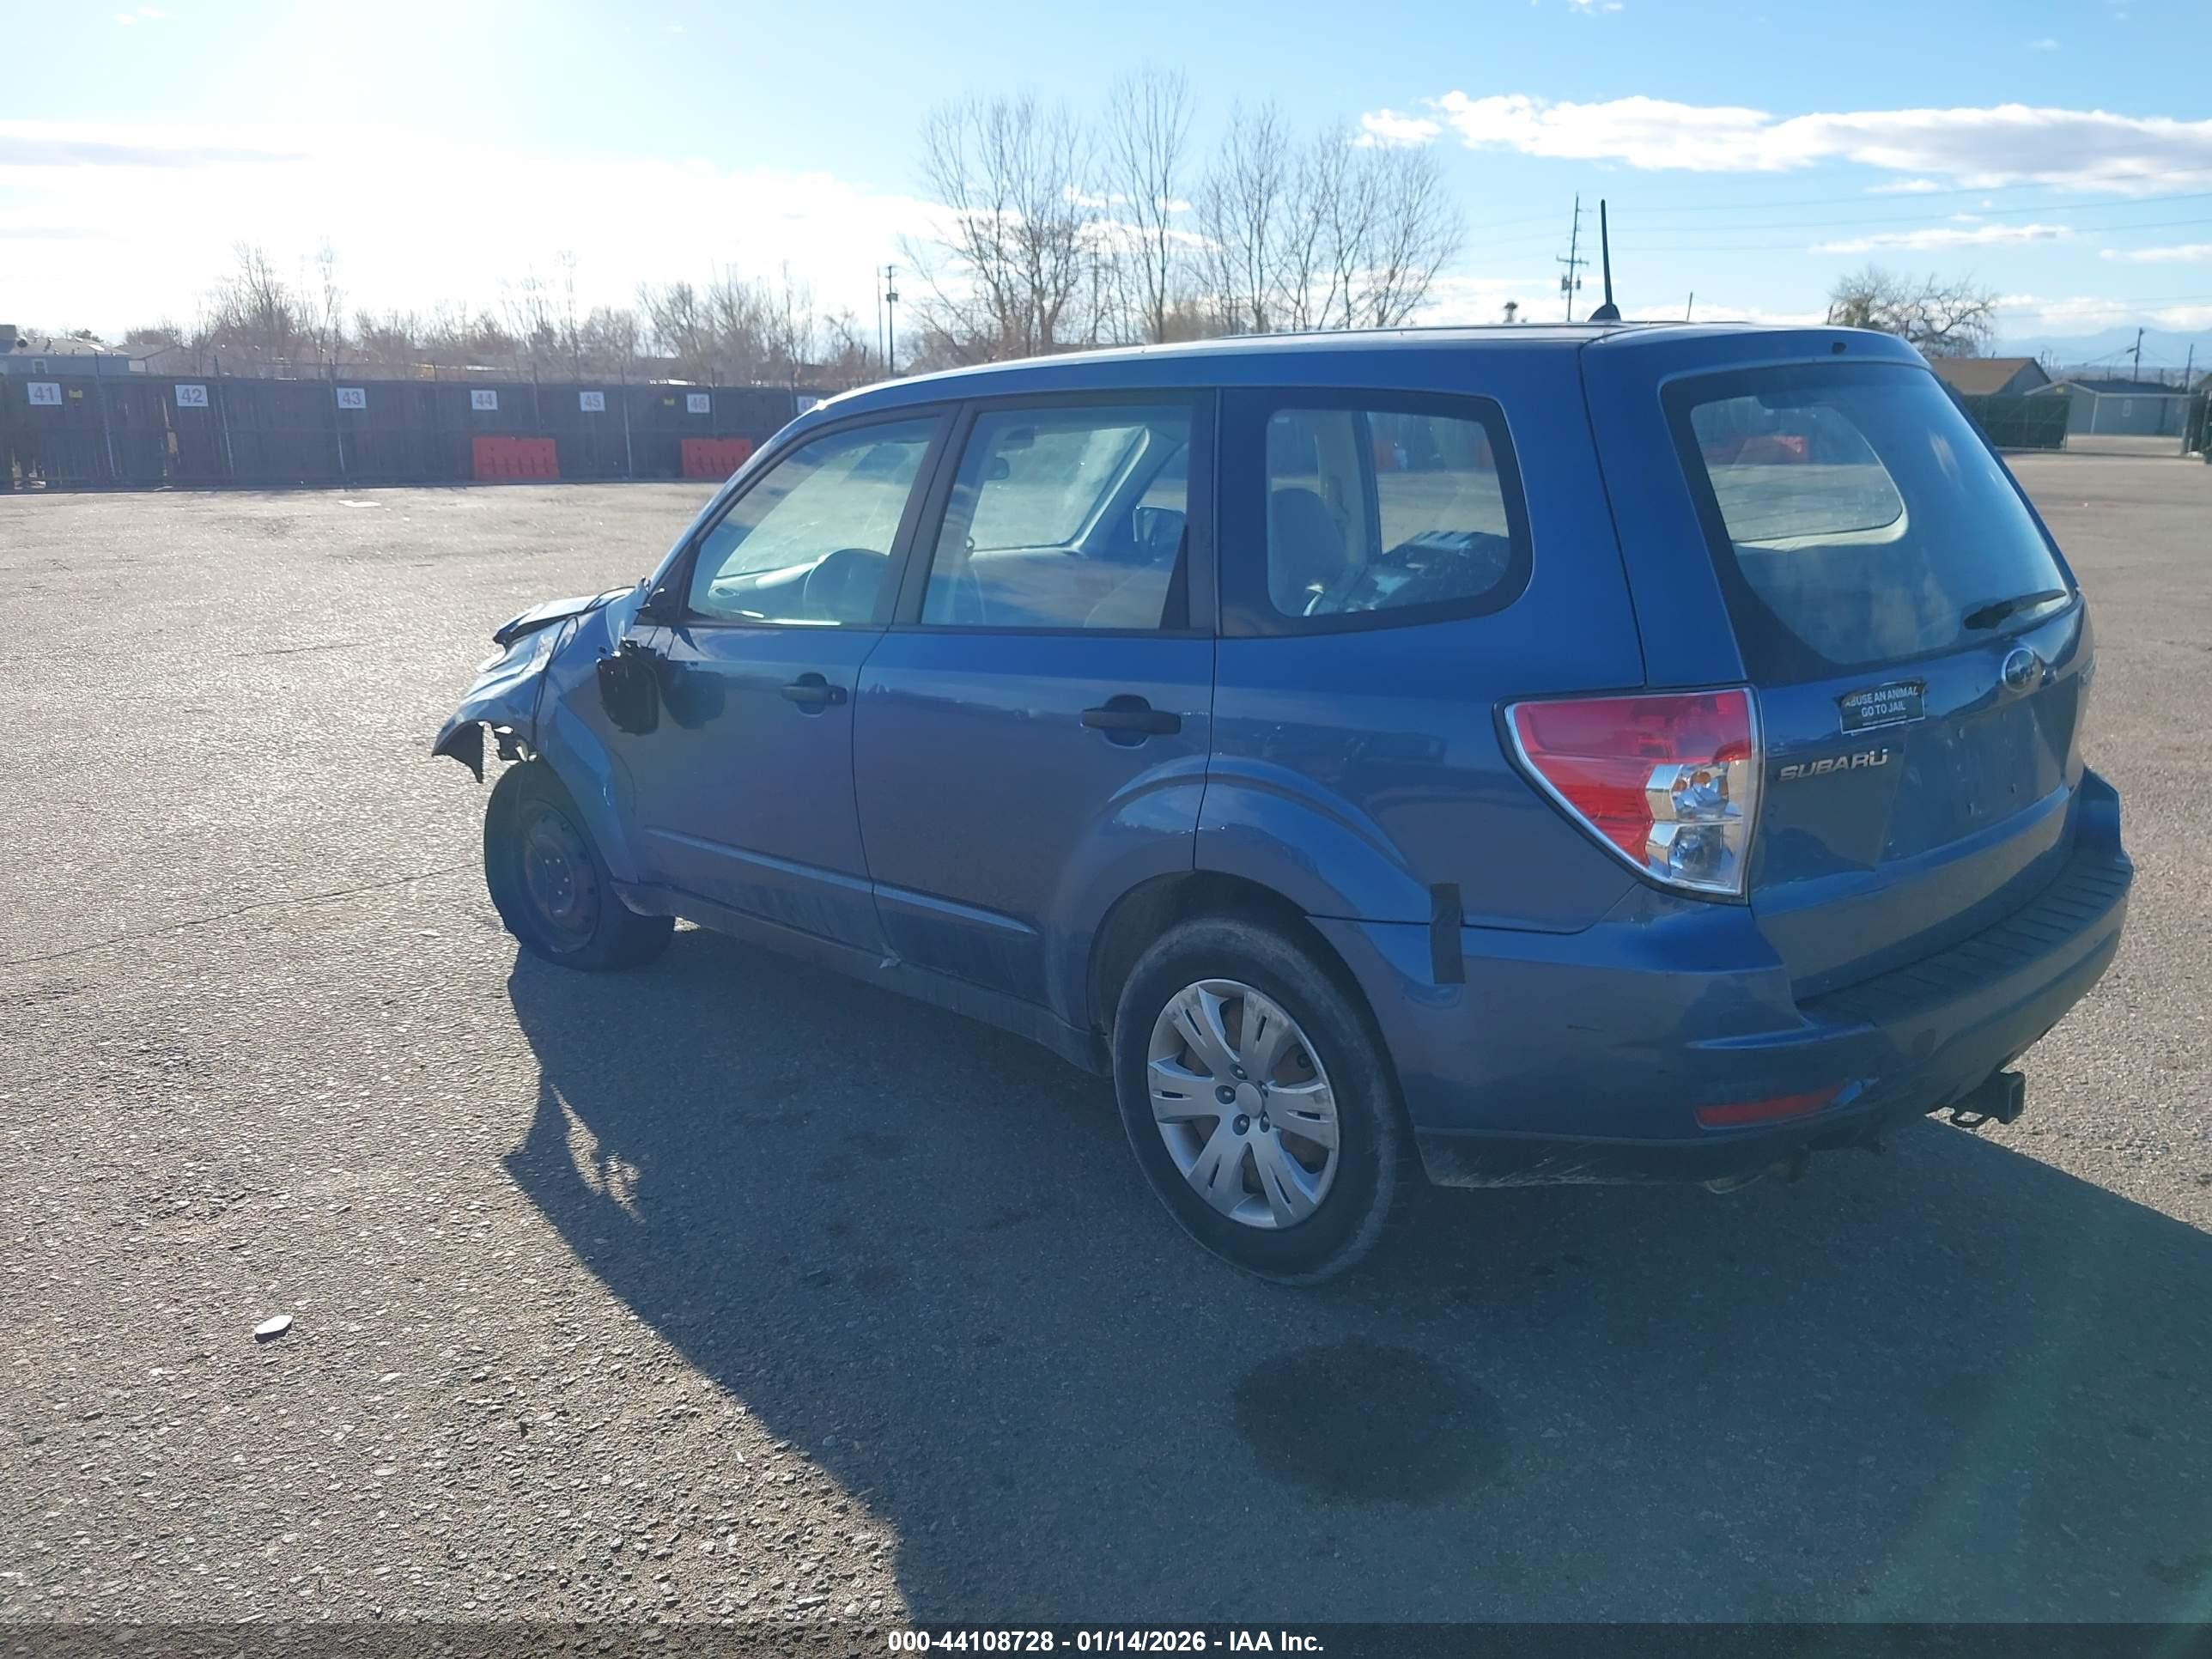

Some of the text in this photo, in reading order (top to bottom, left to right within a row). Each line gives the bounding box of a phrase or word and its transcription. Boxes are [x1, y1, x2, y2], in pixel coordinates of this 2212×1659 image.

[34, 386, 54, 401] 41
[182, 388, 203, 403] 42
[343, 391, 361, 405] 43
[477, 393, 493, 406] 44
[585, 396, 600, 407] 45
[690, 398, 707, 410] 46
[1874, 690, 1887, 702] AN
[1887, 686, 1918, 700] ANIMAL
[1861, 701, 1906, 718] GO TO JAIL
[1778, 748, 1889, 781] SUBARU
